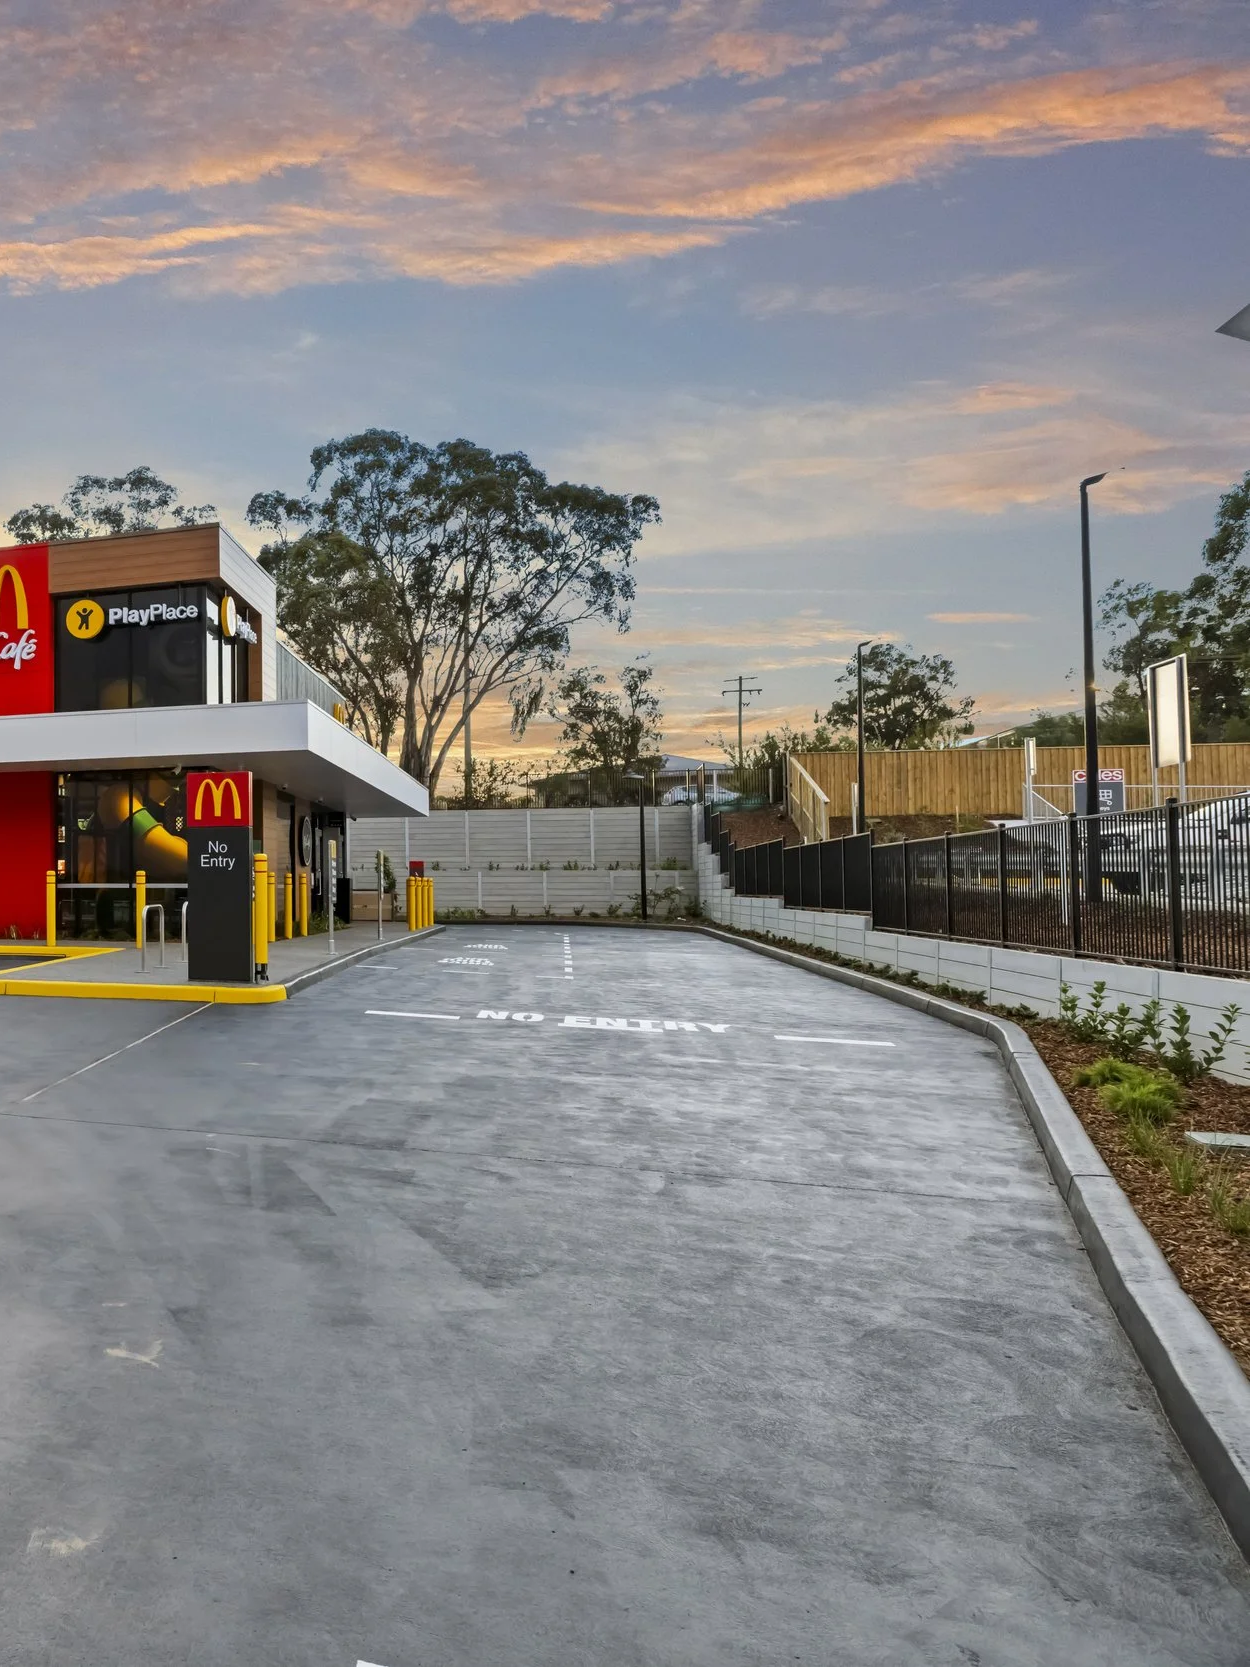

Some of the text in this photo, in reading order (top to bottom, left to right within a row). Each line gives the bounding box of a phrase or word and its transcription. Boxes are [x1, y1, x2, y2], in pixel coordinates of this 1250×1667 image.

[108, 603, 199, 627] PlayPlace
[1074, 770, 1123, 781] cles
[208, 841, 228, 853] No
[200, 854, 236, 871] Entry
[476, 1009, 731, 1033] NO ENTRY
